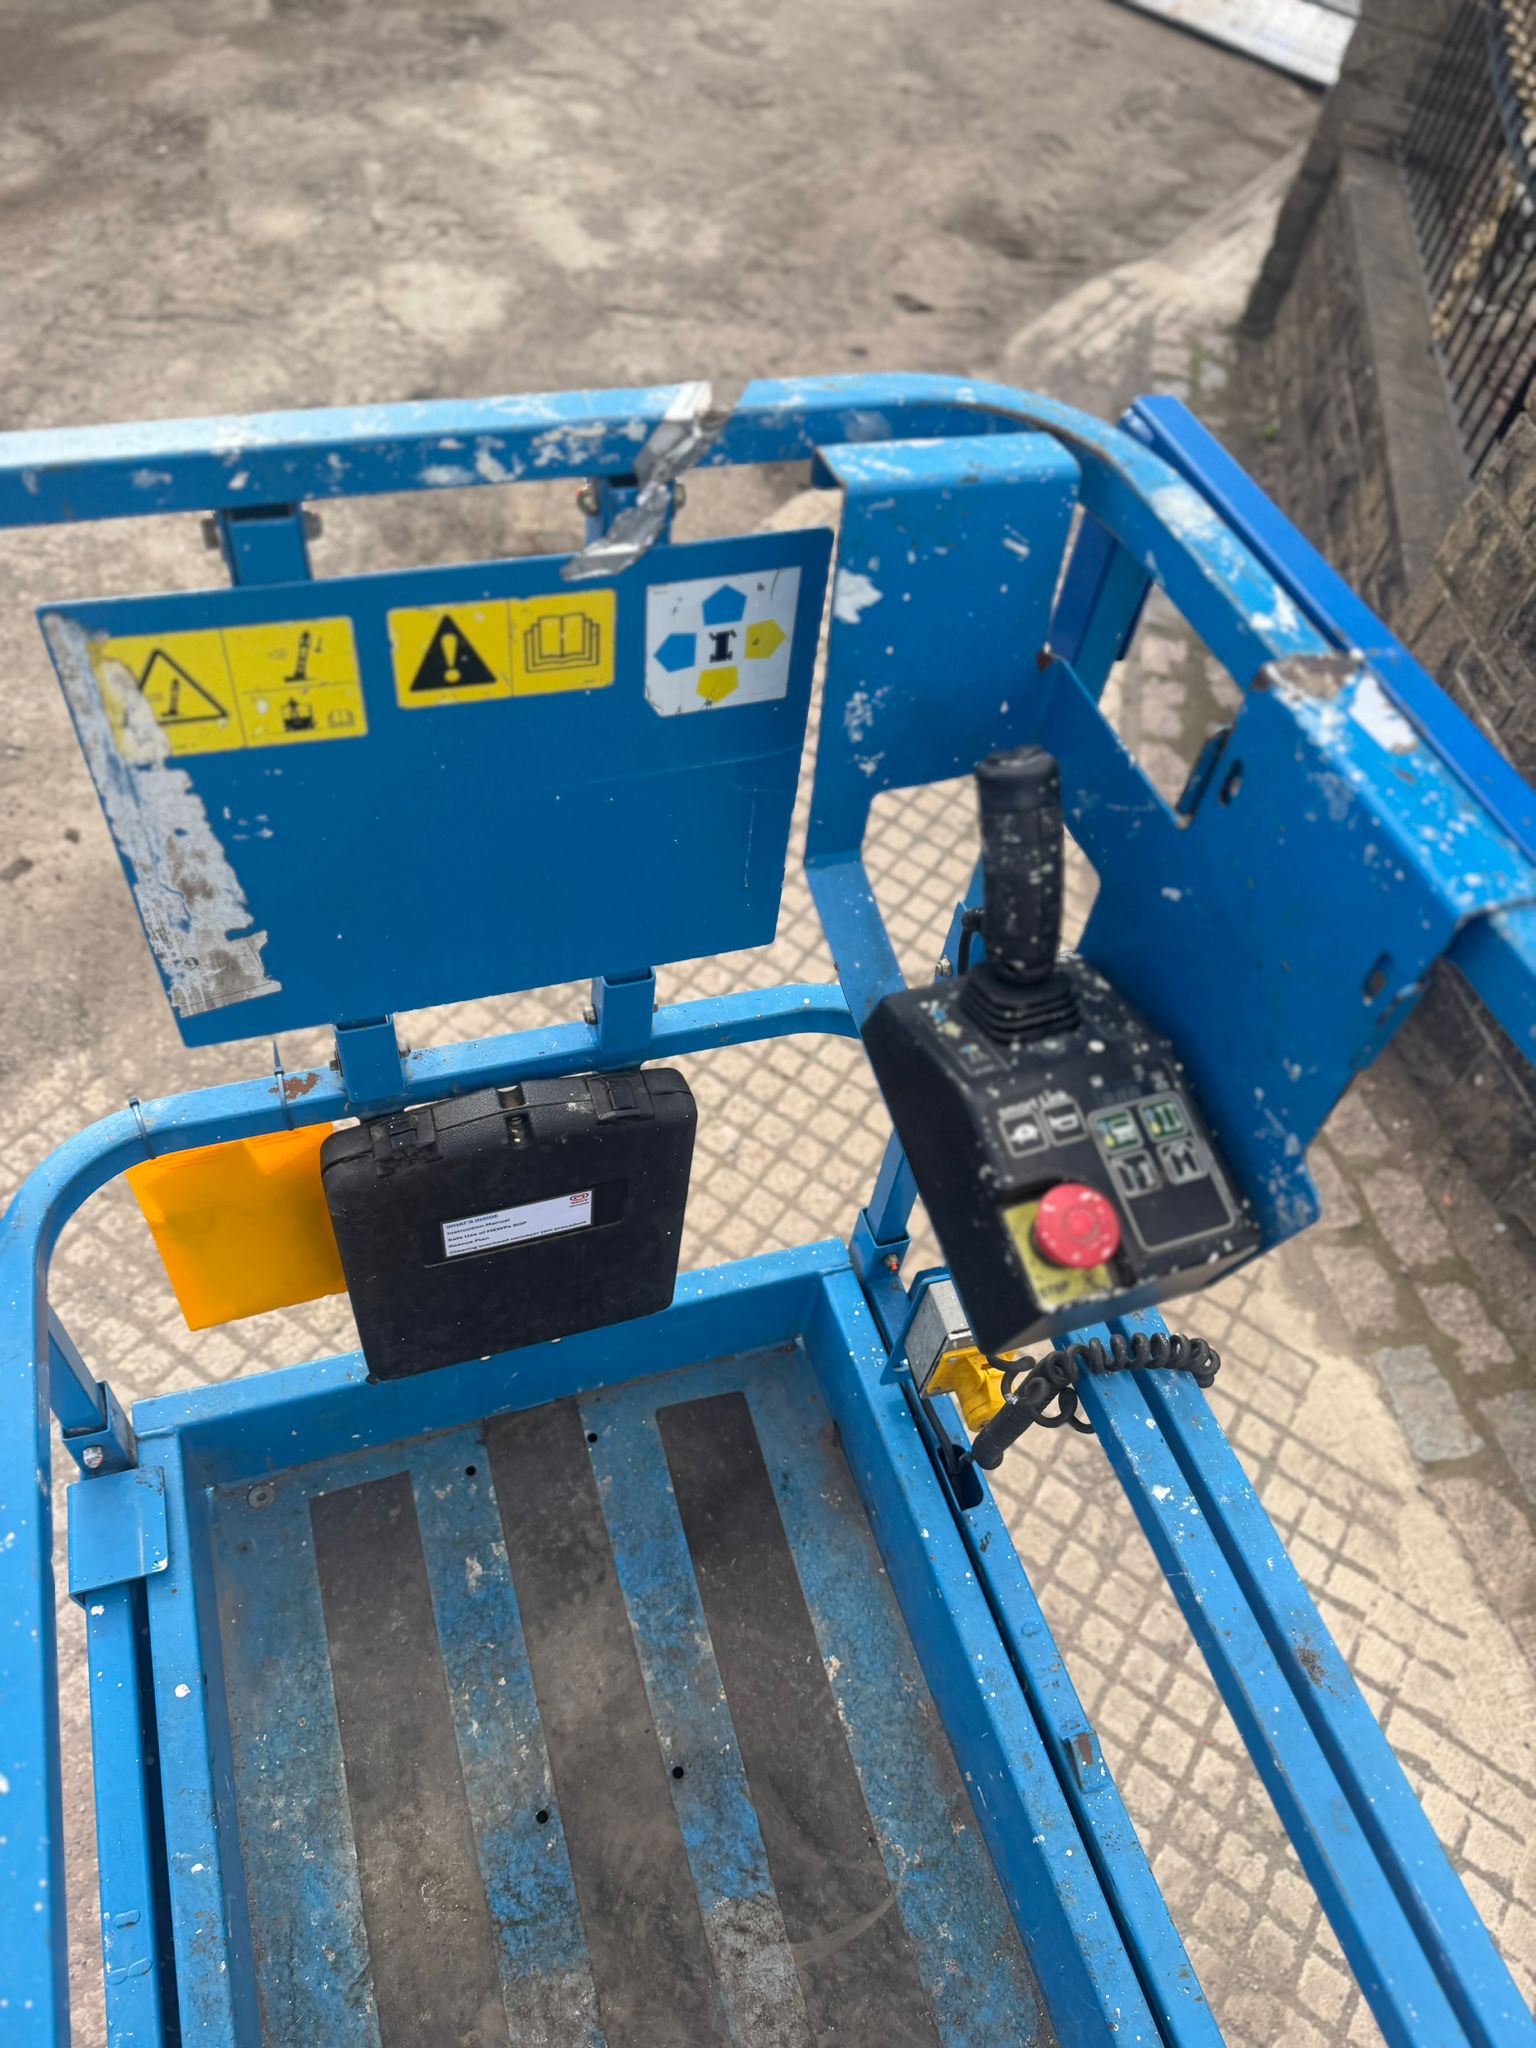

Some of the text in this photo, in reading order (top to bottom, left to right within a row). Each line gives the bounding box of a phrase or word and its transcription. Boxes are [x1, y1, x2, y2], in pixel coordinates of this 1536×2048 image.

[446, 1213, 498, 1229] WHAT'S INSIDE
[447, 1218, 511, 1235] Instruction Manual
[448, 1240, 473, 1248] Rescue
